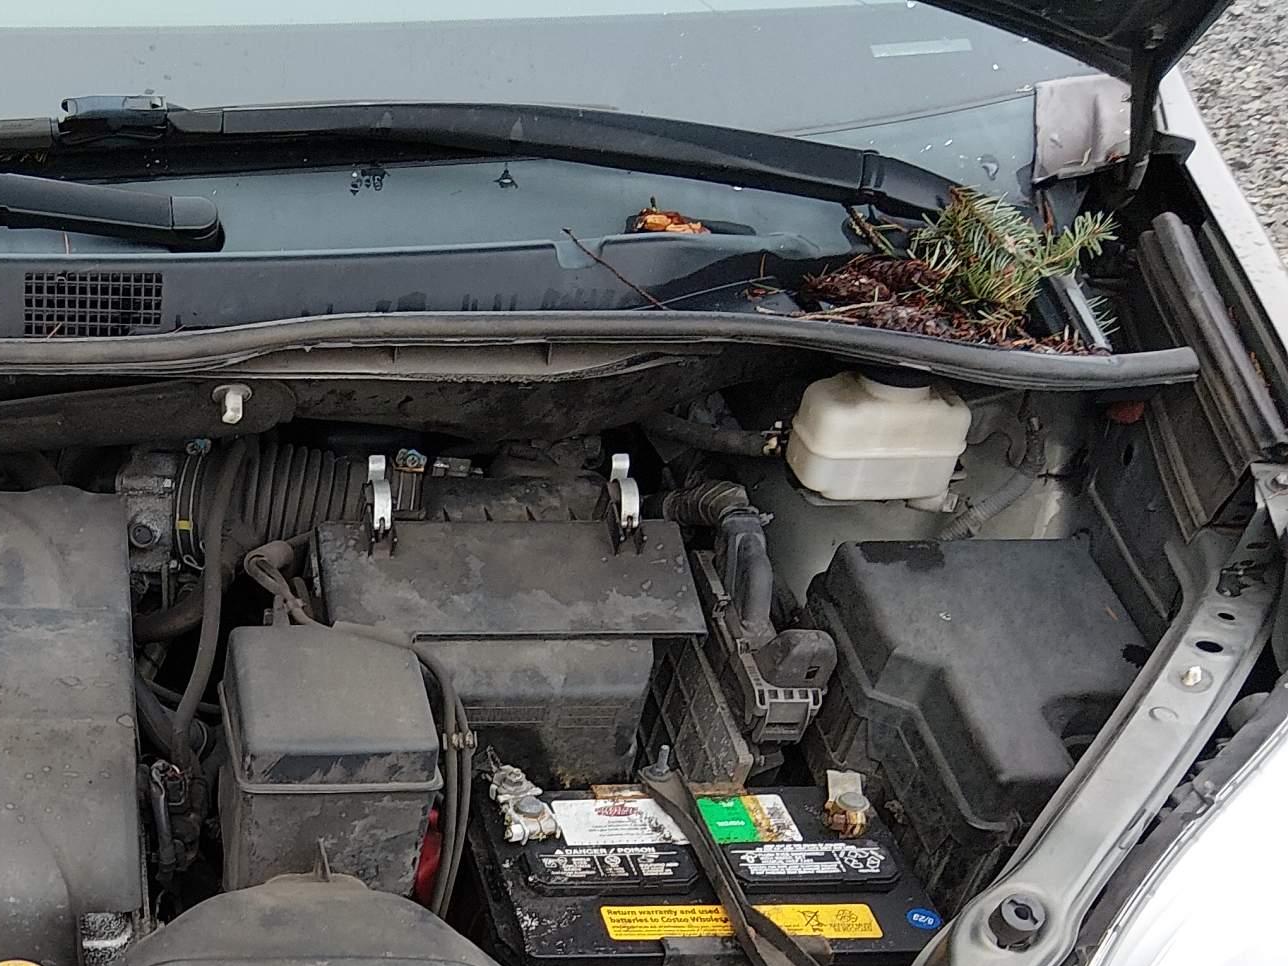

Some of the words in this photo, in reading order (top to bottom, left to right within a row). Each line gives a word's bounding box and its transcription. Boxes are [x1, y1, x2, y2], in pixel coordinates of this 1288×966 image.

[638, 909, 678, 917] warranty
[679, 907, 697, 915] and
[698, 907, 720, 915] used
